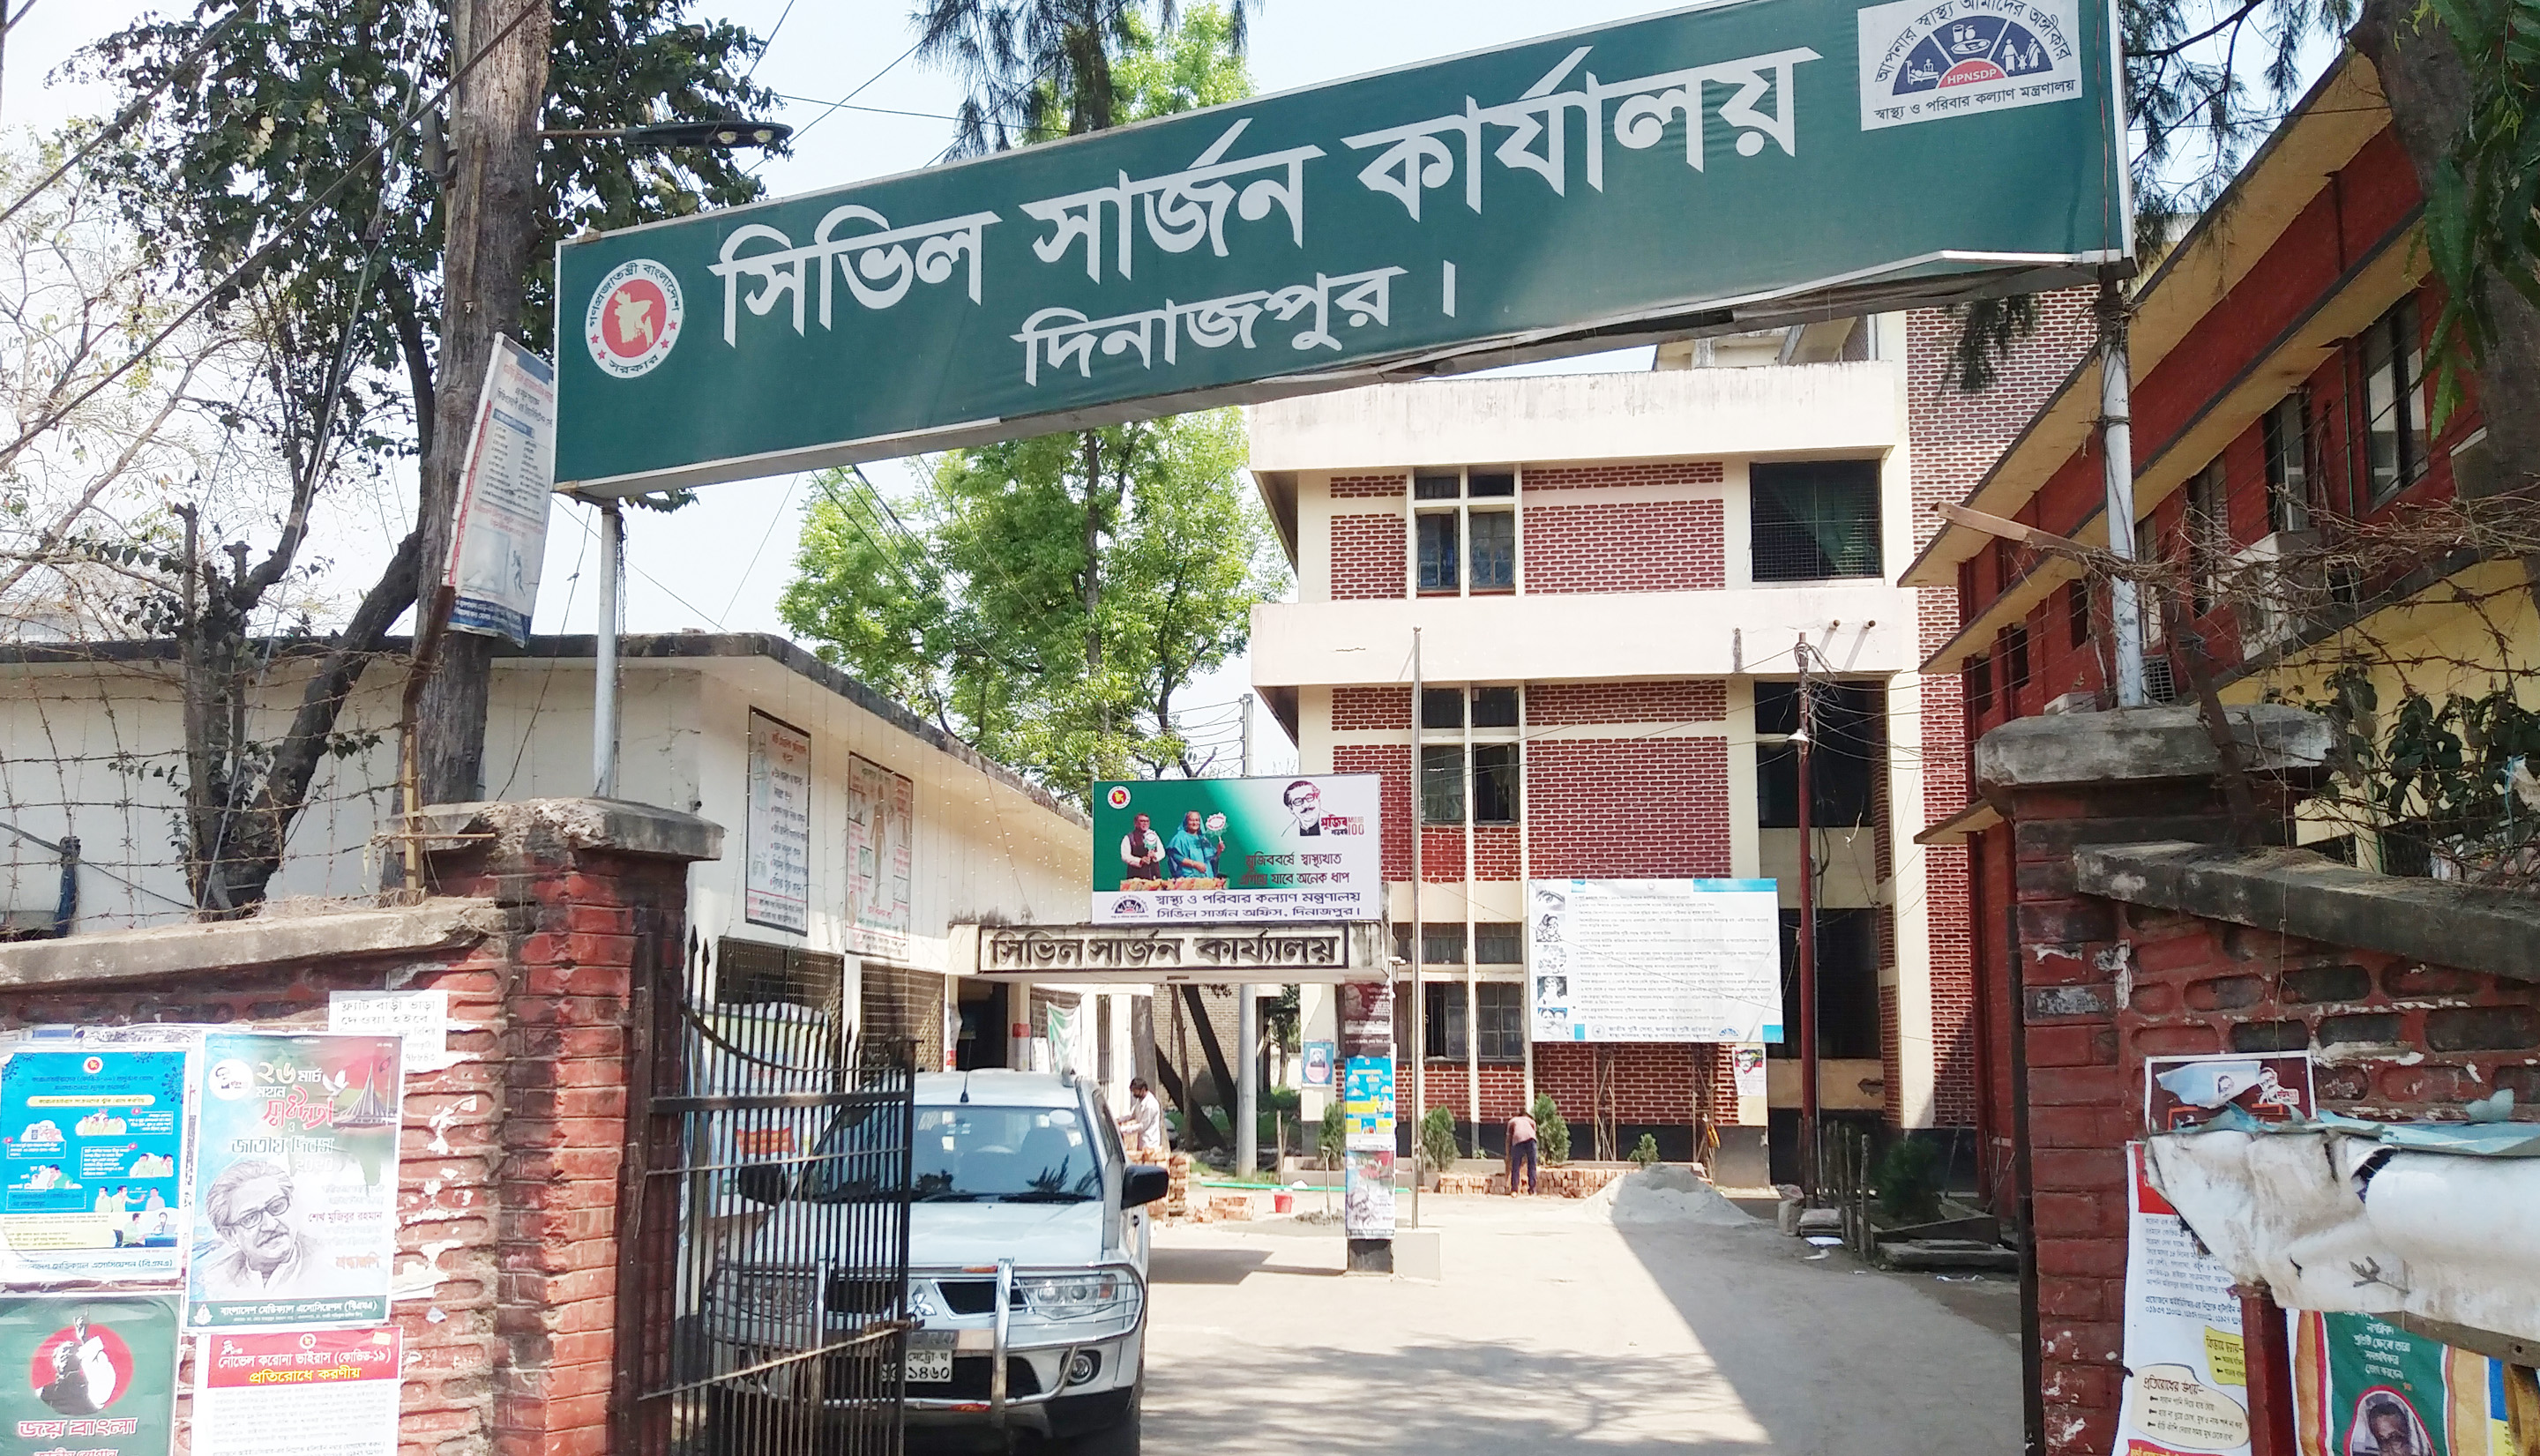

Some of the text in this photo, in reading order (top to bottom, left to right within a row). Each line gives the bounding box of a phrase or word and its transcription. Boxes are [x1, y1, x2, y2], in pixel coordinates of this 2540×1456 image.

[1875, 26, 1917, 82] আপনার
[2029, 7, 2073, 61] অঙ্গীকার
[1946, 68, 1998, 85] HPNSDP
[1873, 79, 2076, 120] স্বাস্থ্য ও পরিবার কল্যাণ মন্ত্রণালয়
[707, 45, 1824, 348] সিভিল সার্জন কার্যালয়
[589, 262, 681, 328] গণপ্রজাতন্ত্রী বাংলাদেশ
[1011, 265, 1408, 386] দিনাজপুর
[609, 354, 659, 374] সরকার
[1320, 814, 1348, 830] মুজিব
[1348, 824, 1364, 835] 100
[1245, 850, 1342, 870] মুজিববর্ষে স্বাস্থ্যখাত
[1271, 872, 1294, 885] যাবে
[1296, 872, 1327, 885] অনেক
[1331, 871, 1349, 884] ধাপ
[1155, 894, 1183, 907] স্বাস্থ্য
[1203, 892, 1251, 904] পরিবার
[1255, 893, 1297, 904] কল্যাণ
[1302, 892, 1361, 905] মন্ত্রণালয়
[1156, 907, 1196, 918] সিভিল
[1200, 907, 1238, 917] সার্জন
[1243, 906, 1288, 918] অফিস,
[988, 930, 1084, 967] সিভিল
[1087, 927, 1184, 967] সার্জন
[409, 1001, 435, 1012] ভাড়া
[257, 1061, 323, 1085] ২৬ মার্চ
[256, 1086, 286, 1099] মহান
[262, 1084, 334, 1131] স্বাধীনতা
[232, 1135, 335, 1156] জাতীয় দিবস
[295, 1157, 334, 1172] ২০২০
[309, 1209, 383, 1223] শেখ মুজিবুর রহমান
[220, 1305, 257, 1316] বাংলাদেশ
[218, 1347, 391, 1369] নোভেল করোনা ভাইরাস (কোভিড-১৯)
[249, 1365, 361, 1384] প্রতিরোধে করণীয়
[2143, 1374, 2179, 1393] প্রতিরোধের
[18, 1417, 138, 1438] জয় বাংলা
